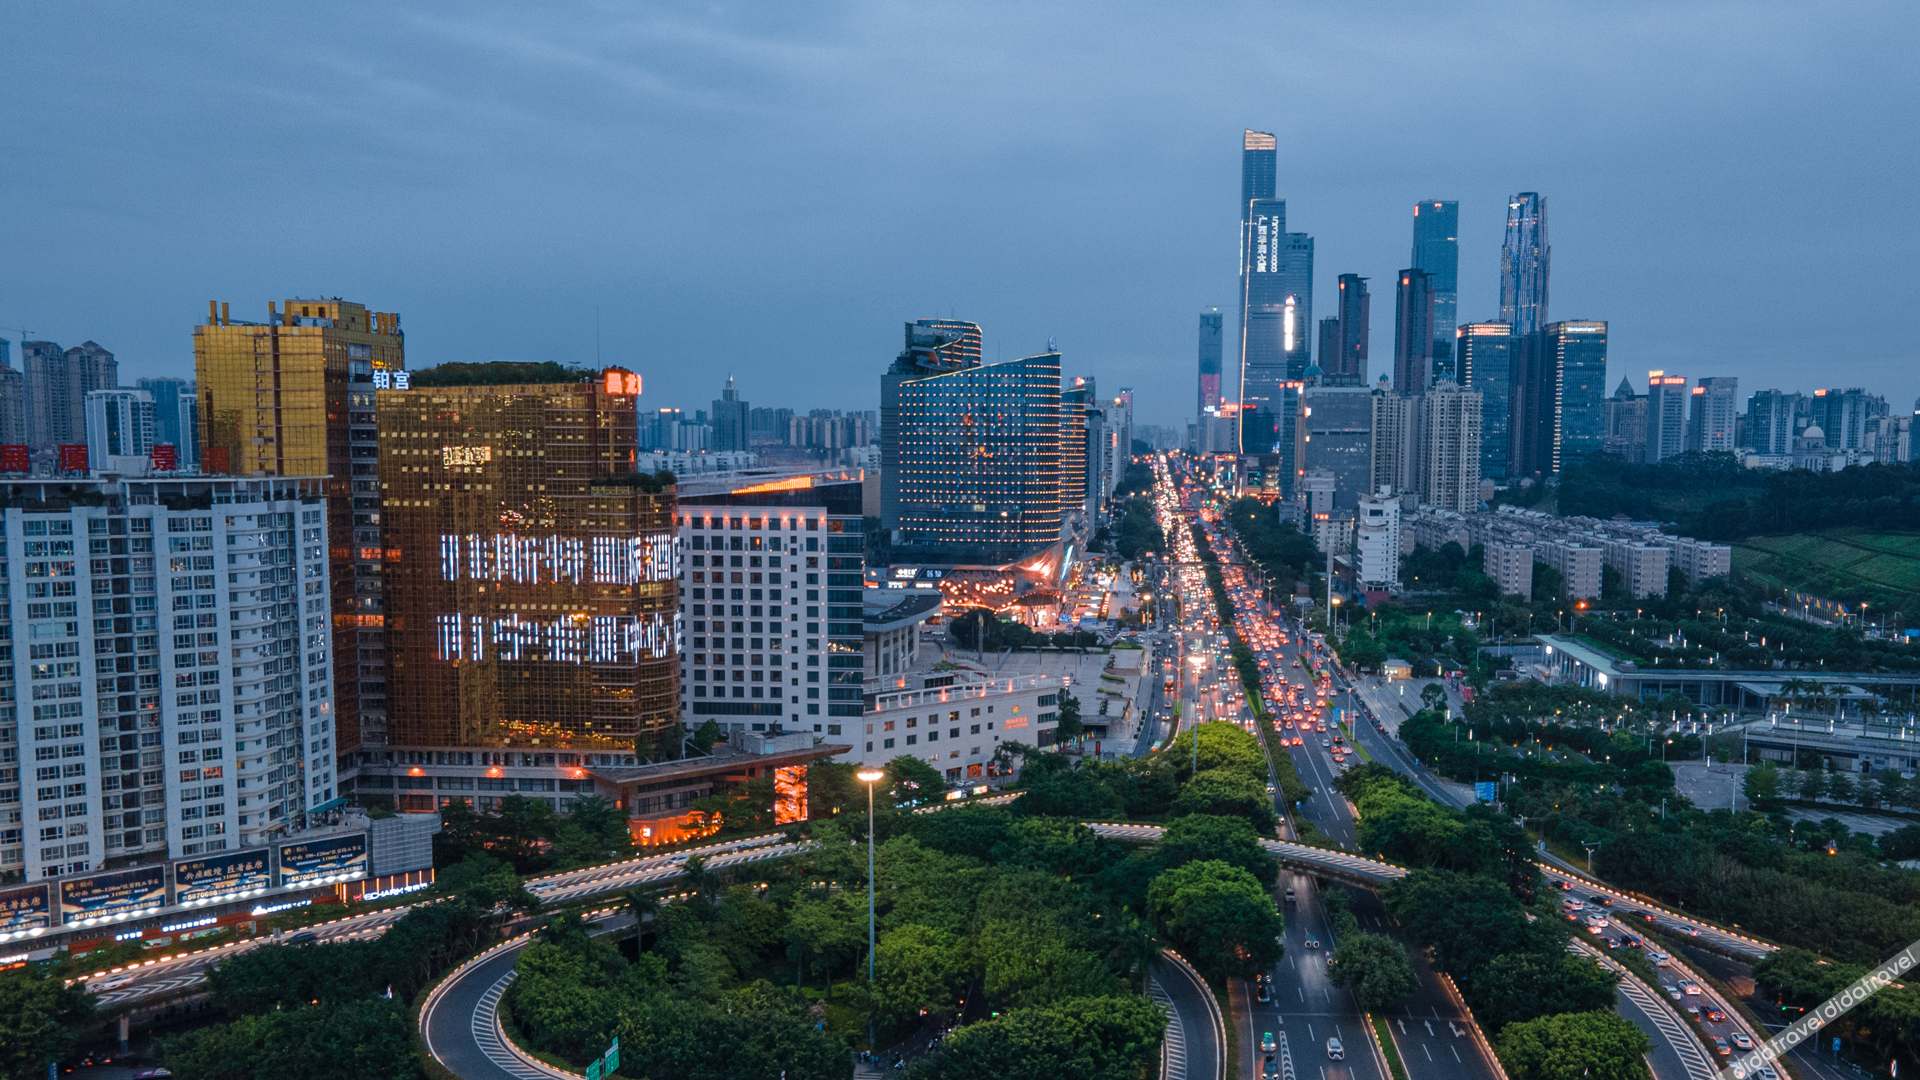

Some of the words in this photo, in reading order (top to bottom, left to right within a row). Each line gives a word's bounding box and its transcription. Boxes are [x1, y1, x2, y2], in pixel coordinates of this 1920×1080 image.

[373, 370, 410, 390] 铂宫
[437, 612, 681, 666] 南宁会展中心
